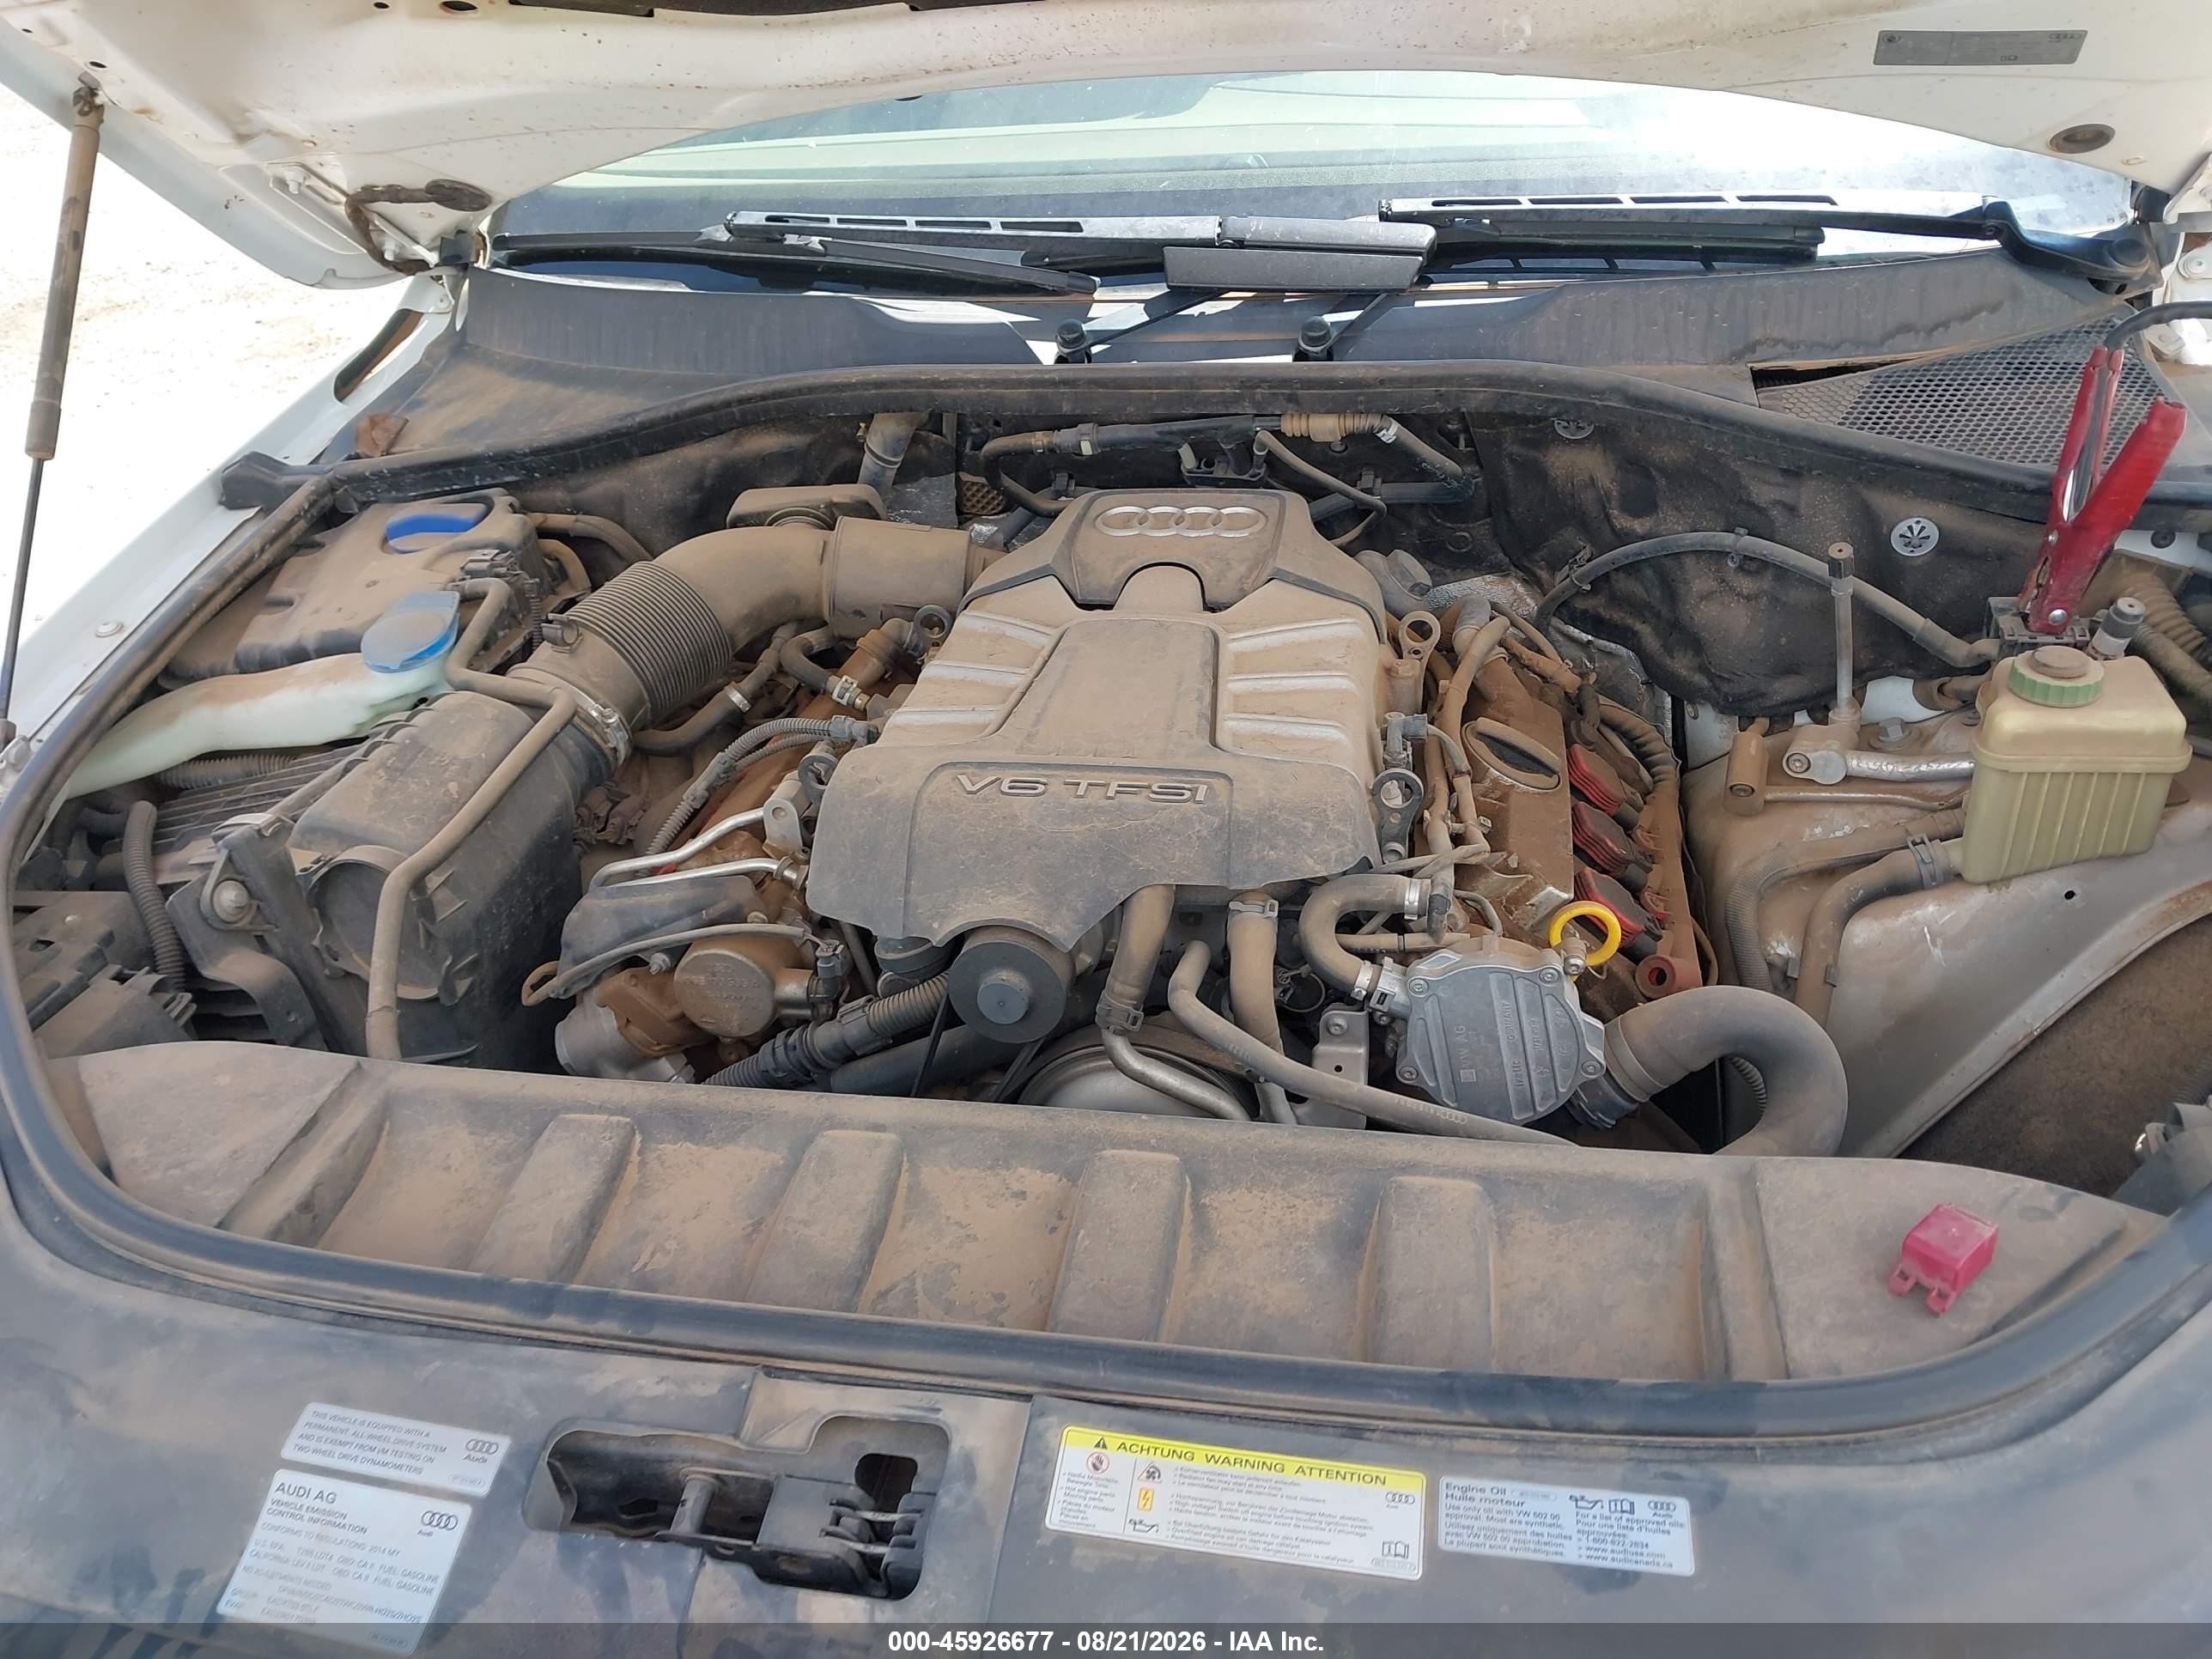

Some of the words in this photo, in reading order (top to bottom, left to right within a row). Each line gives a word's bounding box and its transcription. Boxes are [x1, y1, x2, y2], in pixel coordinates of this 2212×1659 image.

[956, 774, 1049, 797] V6
[1064, 778, 1209, 805] TFSI
[312, 1411, 328, 1419] THIS
[329, 1414, 357, 1425] VEHICLE
[367, 1420, 404, 1433] EQUIPPED
[404, 1427, 424, 1437] WITH
[324, 1437, 354, 1449] EXEMPT
[355, 1443, 377, 1453] FROM
[391, 1449, 422, 1461] TESTING
[393, 1437, 415, 1447] DRIVE
[416, 1442, 447, 1453] SYSTEM
[292, 1444, 311, 1454] TWO
[337, 1452, 359, 1462] DRIVE
[361, 1456, 425, 1474] DYNAMOMETERS
[463, 1453, 489, 1464] Audi
[1116, 1441, 1195, 1462] ACHTUNG
[1205, 1453, 1285, 1474] WARNING
[1294, 1465, 1388, 1486] ATTENTION
[275, 1482, 312, 1499] AUDI
[313, 1489, 339, 1504] AG
[1445, 1482, 1486, 1495] Engine
[1490, 1486, 1506, 1495] Oil
[1445, 1492, 1475, 1503] Huile
[1479, 1497, 1525, 1507] moteur
[270, 1499, 304, 1512] VEHICLE
[306, 1506, 348, 1520] EMISSION
[1462, 1504, 1480, 1514] only
[1496, 1507, 1513, 1516] with
[265, 1508, 307, 1522] CONTROL
[307, 1516, 368, 1534] INFORMATION
[1576, 1510, 1589, 1519] For
[1626, 1516, 1666, 1526] approved
[1576, 1519, 1595, 1528] Pour
[1598, 1521, 1613, 1529] une
[1616, 1522, 1634, 1531] liste
[1477, 1524, 1527, 1537] uniquement
[1529, 1529, 1544, 1538] des
[1547, 1531, 1572, 1540] huiles
[1456, 1539, 1486, 1550] plupart
[1488, 1542, 1506, 1551] sont
